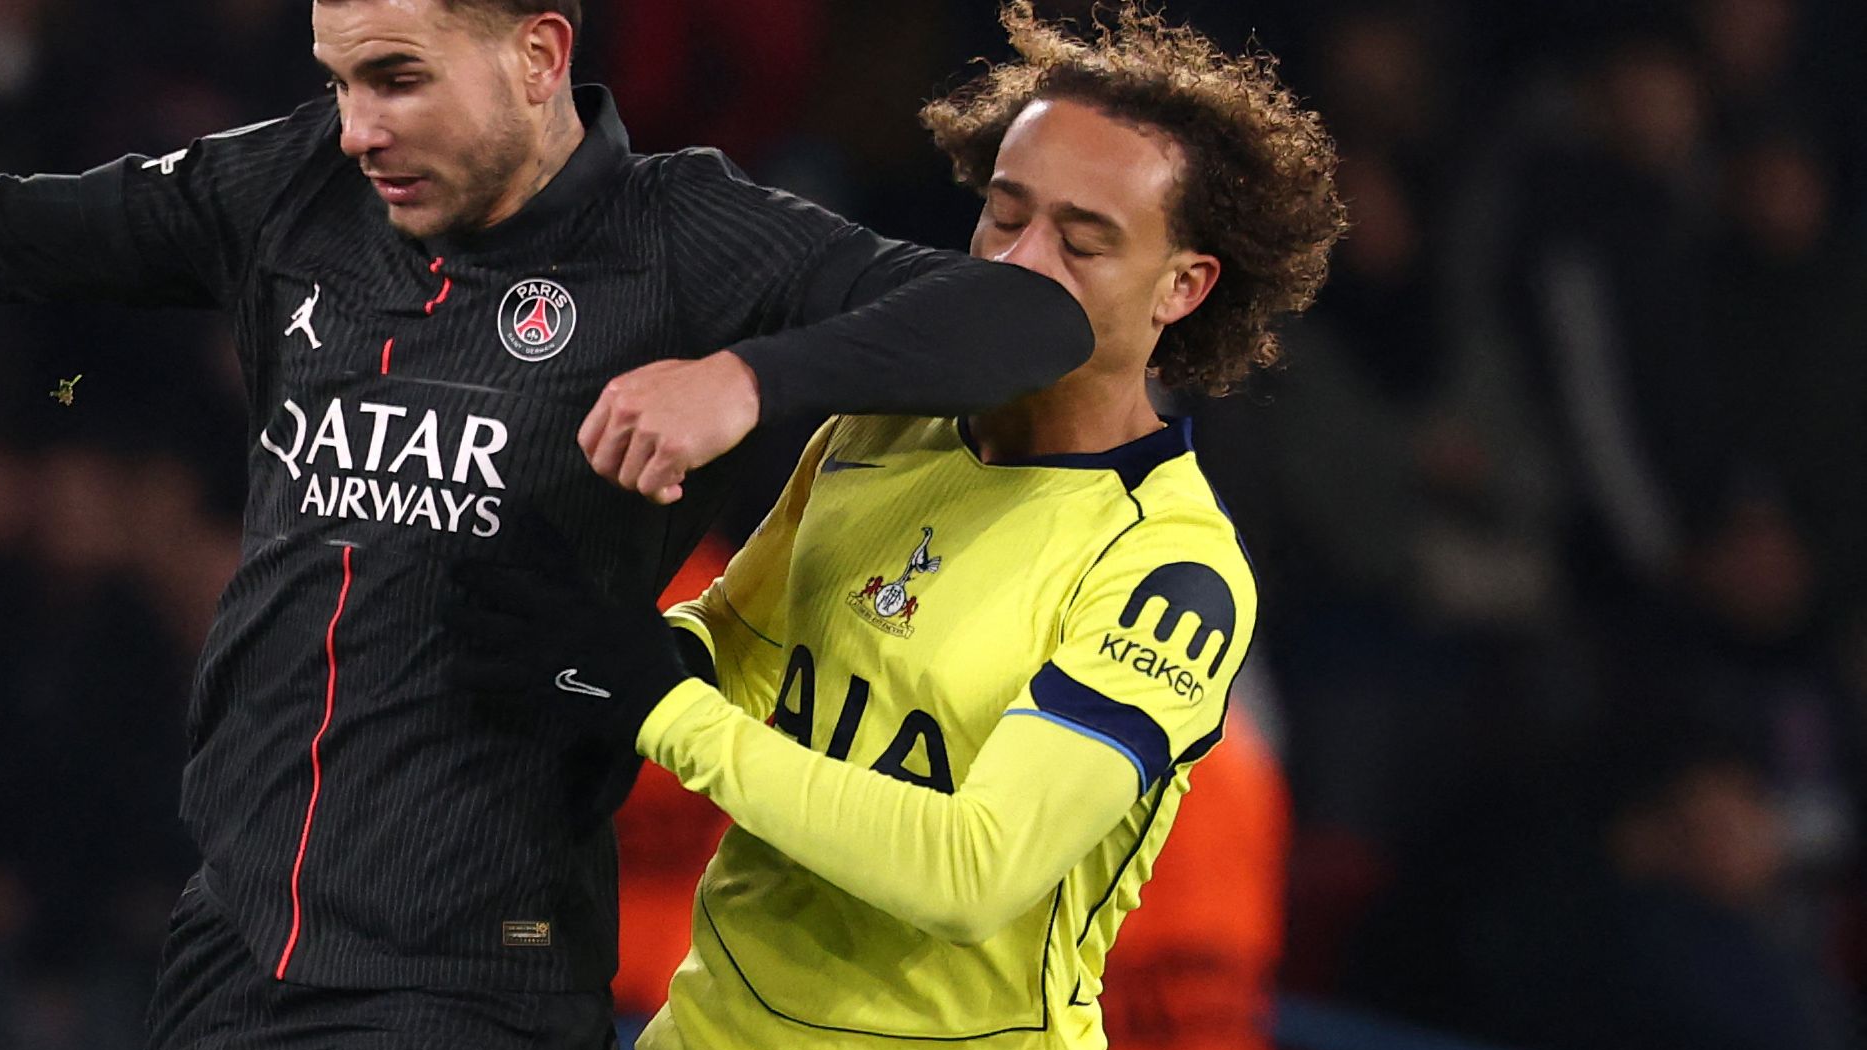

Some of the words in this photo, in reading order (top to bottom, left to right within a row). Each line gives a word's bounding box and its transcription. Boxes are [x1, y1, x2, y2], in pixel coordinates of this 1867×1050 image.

[516, 283, 567, 308] PARIS
[260, 397, 509, 490] QATAR
[300, 473, 502, 538] AIRWAYS
[1098, 632, 1205, 702] kraken
[773, 644, 955, 796] AIA
